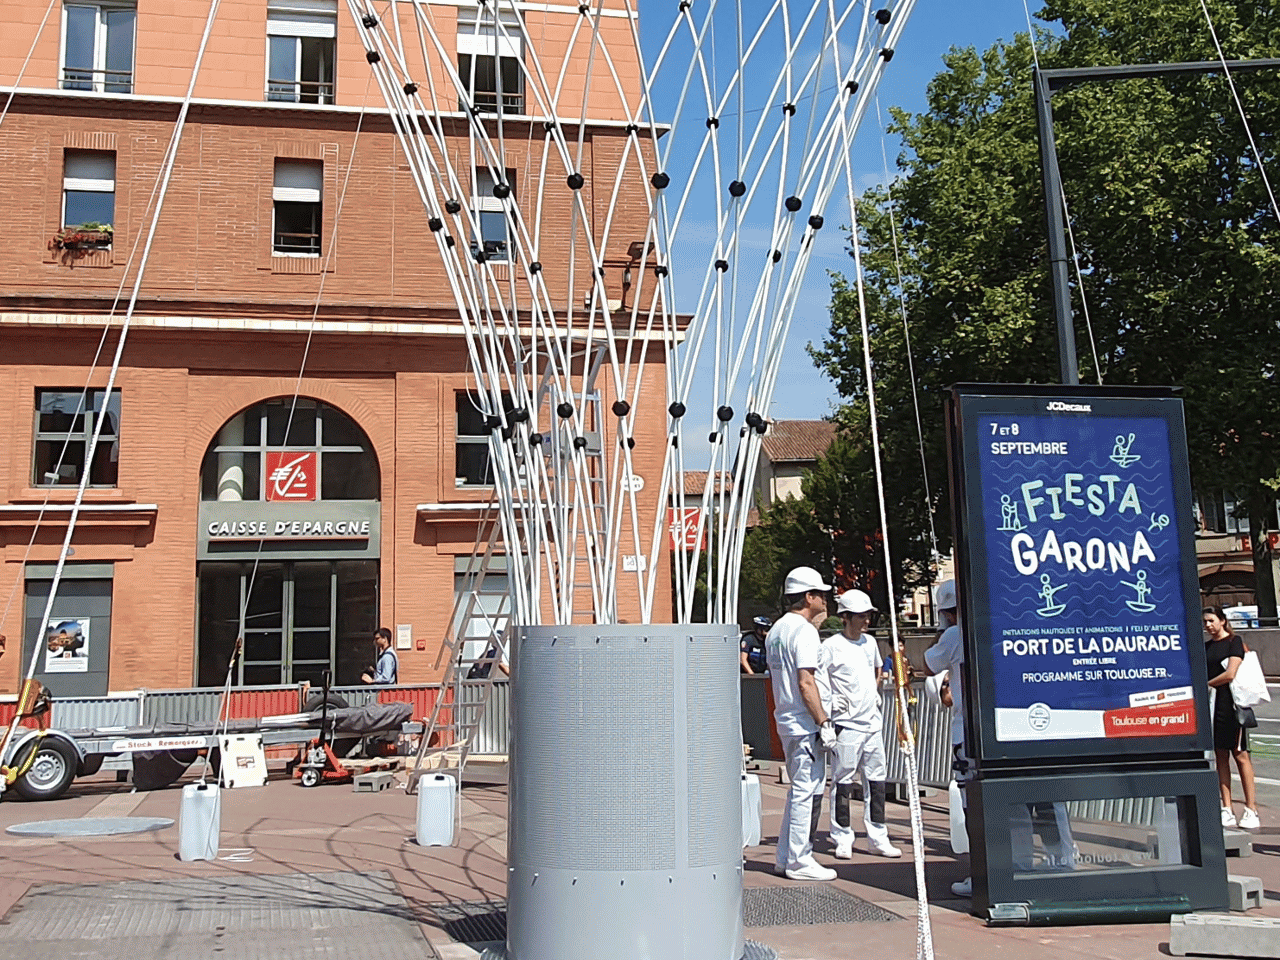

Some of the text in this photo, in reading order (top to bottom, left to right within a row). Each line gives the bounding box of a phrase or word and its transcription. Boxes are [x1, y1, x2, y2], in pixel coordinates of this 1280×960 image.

[1046, 401, 1092, 412] JCDecaux
[990, 423, 1019, 436] 7 ET 8
[991, 442, 1068, 455] SEPTEMBRE
[1021, 473, 1142, 523] FIESTA
[208, 520, 371, 535] CAISSE D'EPARGNE
[1011, 529, 1156, 576] GARONA
[1002, 628, 1040, 636] INITIATIONS
[1041, 627, 1075, 635] NAUTIQUES
[1002, 634, 1182, 657] PORT DE LA DAURADE
[1022, 667, 1167, 683] PROGRAMME SUR TOULOUSE.FR
[1111, 715, 1148, 726] Toulouse
[1148, 716, 1160, 725] en
